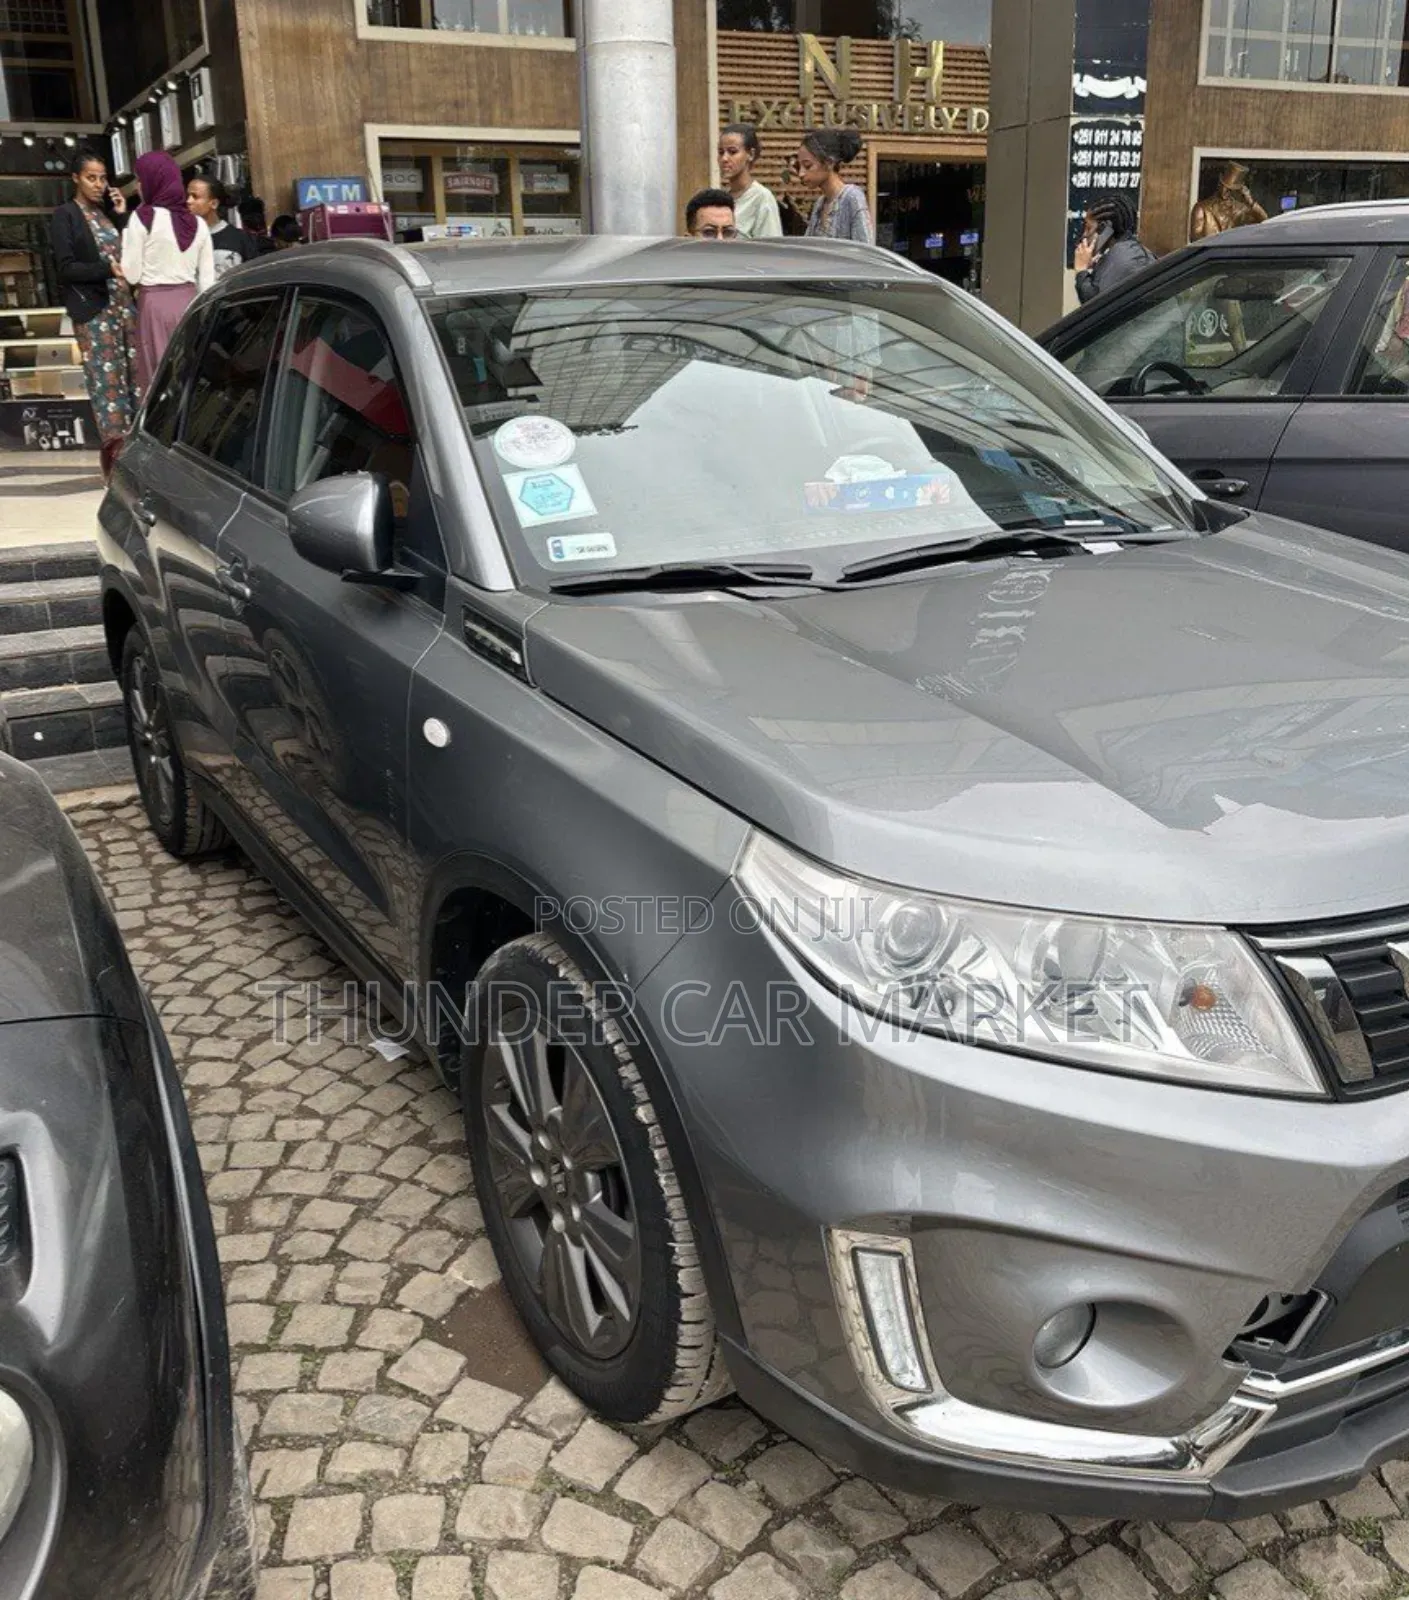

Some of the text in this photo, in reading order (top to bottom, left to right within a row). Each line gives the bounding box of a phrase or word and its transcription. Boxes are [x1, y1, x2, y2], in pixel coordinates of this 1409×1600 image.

[797, 33, 943, 104] N H
[728, 101, 962, 133] EXCLUSIVELY
[1073, 129, 1093, 145] +251
[1072, 150, 1092, 167] +251
[1071, 171, 1091, 188] +251
[305, 184, 361, 203] ATM
